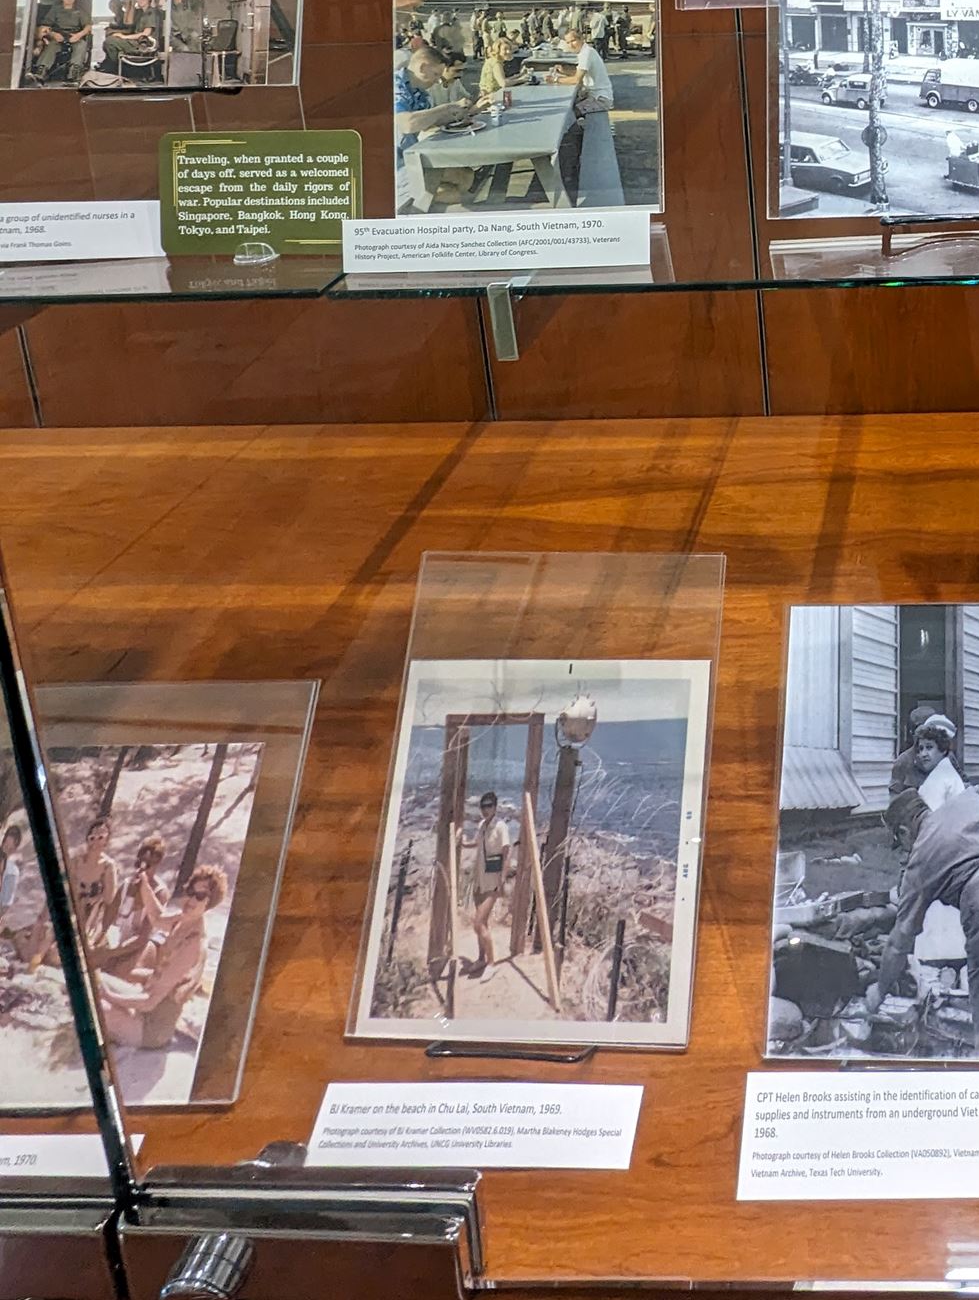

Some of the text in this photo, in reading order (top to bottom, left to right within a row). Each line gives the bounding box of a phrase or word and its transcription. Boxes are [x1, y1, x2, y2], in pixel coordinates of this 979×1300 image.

[233, 154, 261, 163] when
[263, 153, 303, 165] granted
[306, 155, 313, 163] a
[315, 152, 348, 164] couple
[178, 168, 189, 178] of
[190, 168, 215, 180] days
[238, 167, 272, 178] served
[275, 169, 287, 177] as
[289, 169, 297, 177] a
[299, 167, 349, 177] welcomed
[178, 181, 350, 194] escape from the daily rigors of
[371, 227, 415, 235] Evacuation
[416, 225, 450, 235] Hospital
[477, 224, 488, 232] Da
[516, 222, 540, 231] South
[756, 1092, 773, 1102] CPT
[775, 1092, 800, 1102] Helen
[802, 1091, 832, 1102] Brooks
[834, 1092, 870, 1103] assisting
[872, 1092, 880, 1100] in
[883, 1090, 897, 1100] the
[899, 1089, 956, 1100] identification
[958, 1088, 968, 1099] of
[329, 1103, 340, 1114] BJ
[339, 1104, 371, 1114] Kramer
[372, 1105, 383, 1114] on
[384, 1103, 400, 1114] the
[400, 1103, 426, 1114] beach
[427, 1103, 436, 1113] in
[437, 1102, 454, 1113] Chu
[471, 1102, 496, 1113] South
